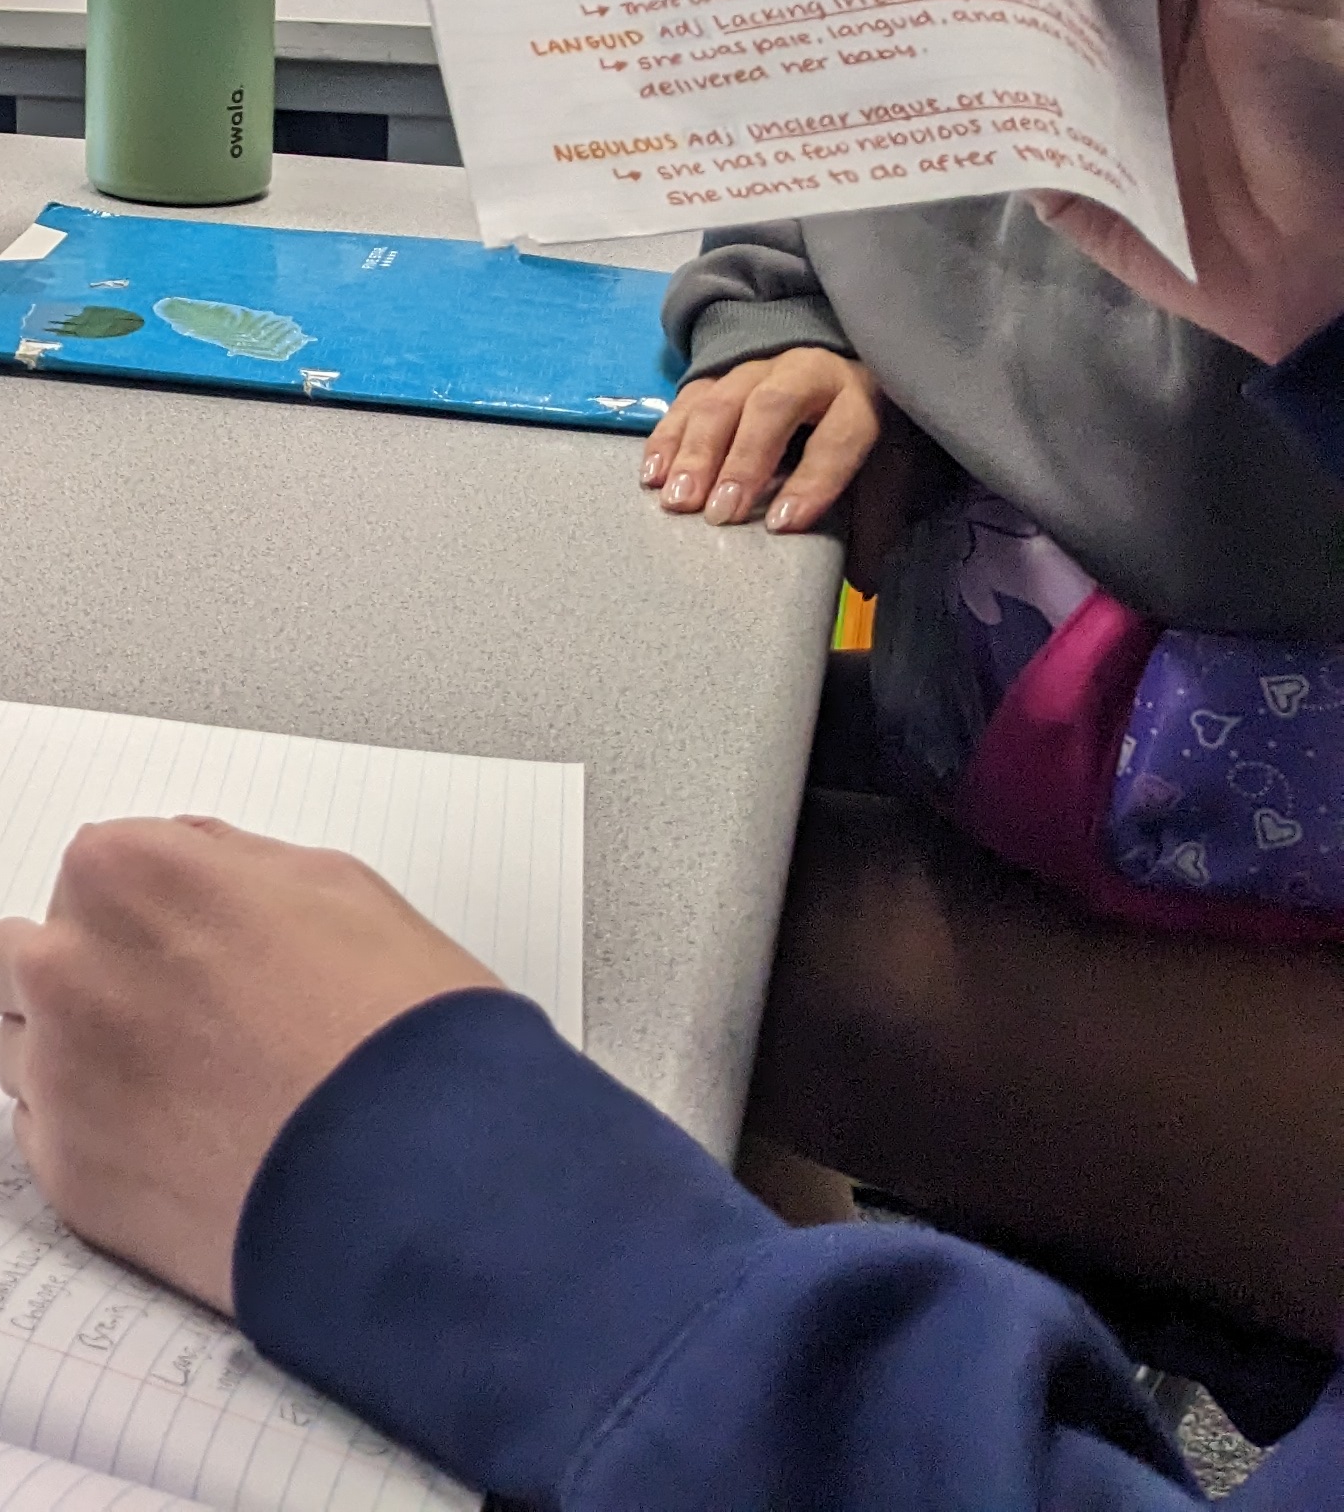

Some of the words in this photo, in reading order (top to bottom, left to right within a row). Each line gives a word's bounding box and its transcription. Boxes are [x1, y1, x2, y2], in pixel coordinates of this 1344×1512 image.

[530, 29, 645, 57] LANGUID
[690, 40, 747, 62] was
[953, 7, 1007, 24] and
[640, 65, 769, 100] delivered
[781, 56, 829, 75] her
[227, 89, 244, 159] owala
[553, 134, 678, 163] NEBULOUS
[957, 91, 984, 108] or
[993, 88, 1065, 118] hazy
[714, 150, 768, 172] has
[774, 151, 796, 164] a
[800, 139, 850, 162] few
[726, 172, 822, 199] wants
[828, 168, 860, 184] to
[869, 163, 908, 182] do
[918, 148, 998, 175] after
